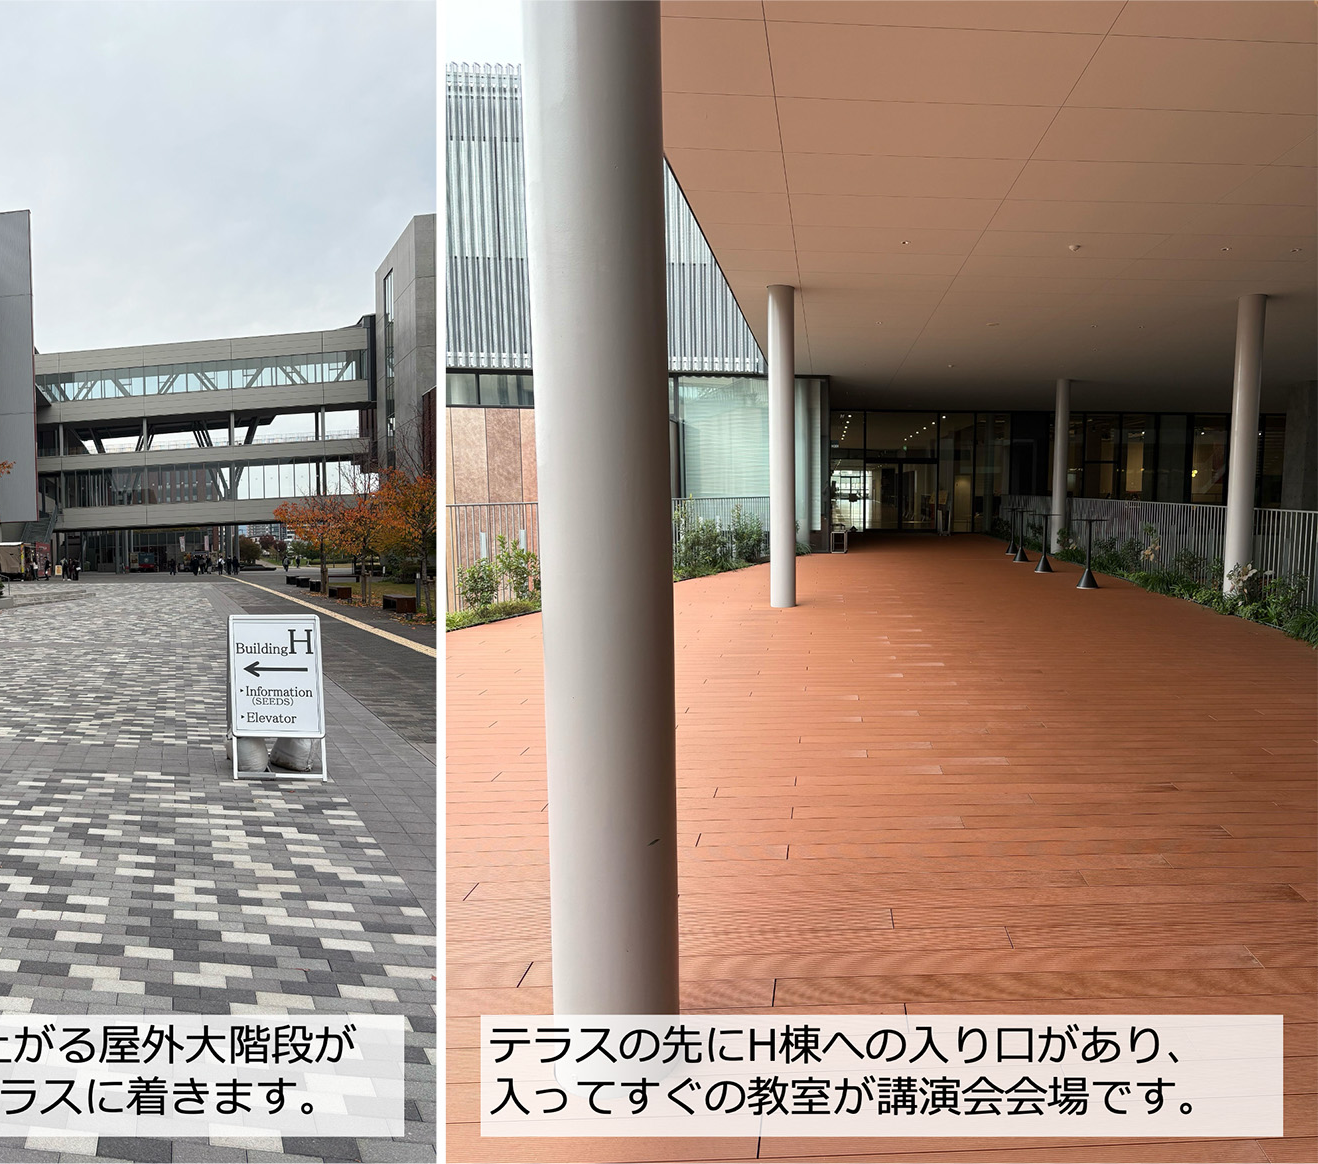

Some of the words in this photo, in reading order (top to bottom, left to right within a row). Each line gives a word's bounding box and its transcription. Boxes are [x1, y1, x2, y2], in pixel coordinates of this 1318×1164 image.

[235, 642, 288, 657] Building
[287, 629, 314, 655] H
[245, 686, 313, 698] Information
[251, 697, 294, 707] (SEEDS)
[246, 712, 297, 724] Elevator
